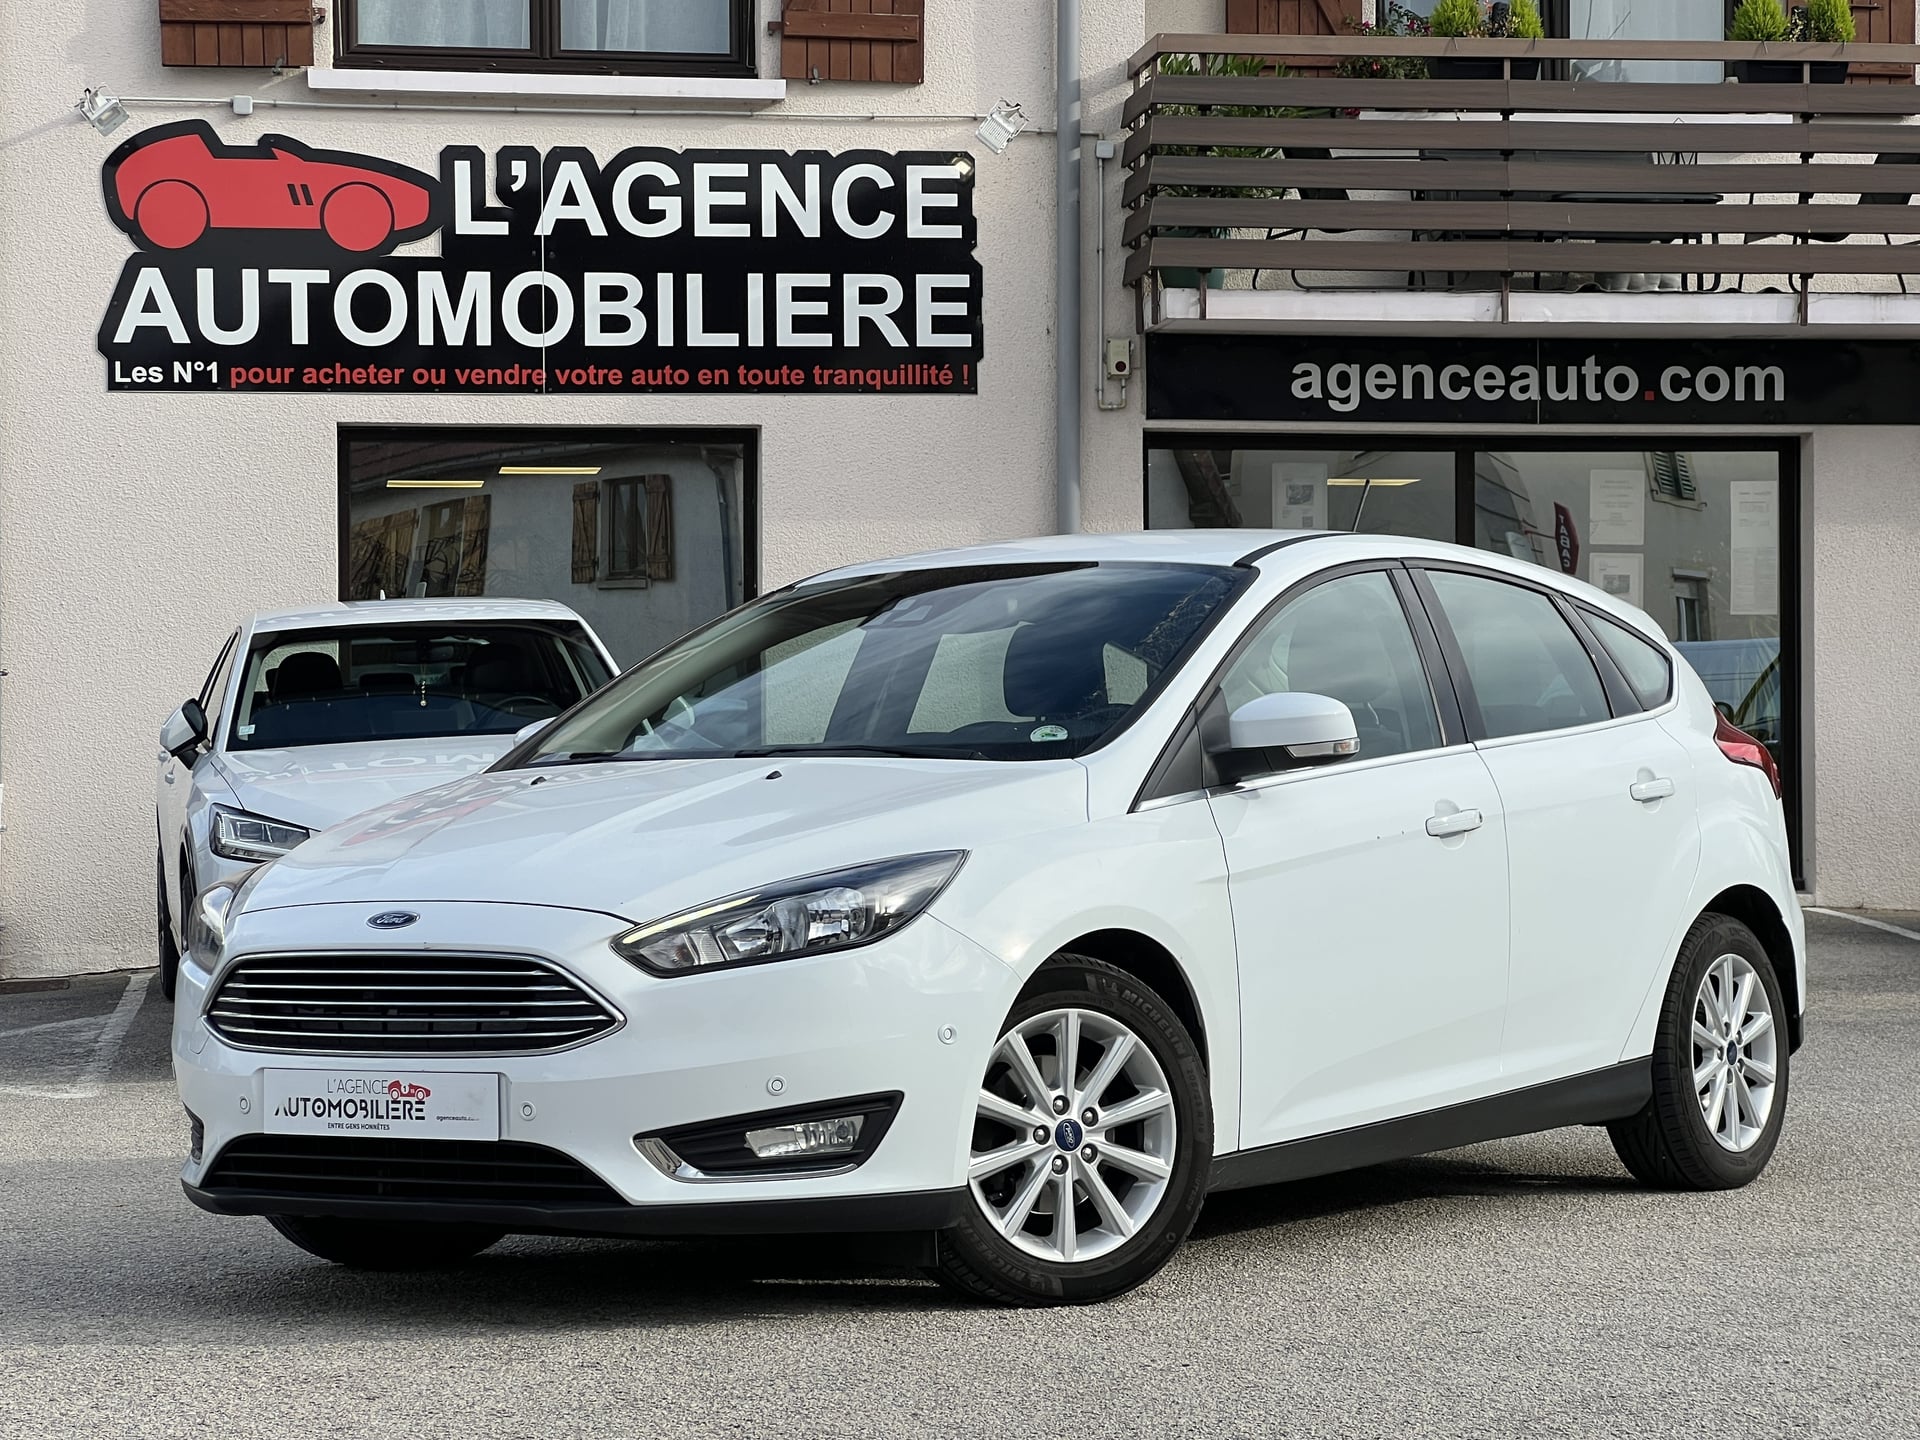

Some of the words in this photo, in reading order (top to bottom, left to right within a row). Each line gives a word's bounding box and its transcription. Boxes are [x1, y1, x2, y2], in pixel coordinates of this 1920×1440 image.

[454, 160, 962, 239] L'AGENCE
[113, 267, 972, 348] AUTOMOBILIERE
[114, 361, 163, 384] Les
[173, 361, 219, 384] N°1
[230, 365, 294, 388] pour
[302, 362, 403, 385] acheter
[412, 366, 446, 385] ou
[455, 363, 546, 386] vendre
[555, 366, 623, 386] votre
[631, 366, 690, 386] auto
[697, 369, 730, 386] en
[738, 366, 805, 386] toute
[813, 363, 953, 390] tranquillité
[962, 364, 970, 386] !
[1291, 354, 1785, 412] agenceauto.com
[1121, 988, 1188, 1056] MICHELIN
[327, 1078, 389, 1095] L'AGENCE
[327, 1122, 344, 1130] ENTRE
[345, 1122, 360, 1130] GENS
